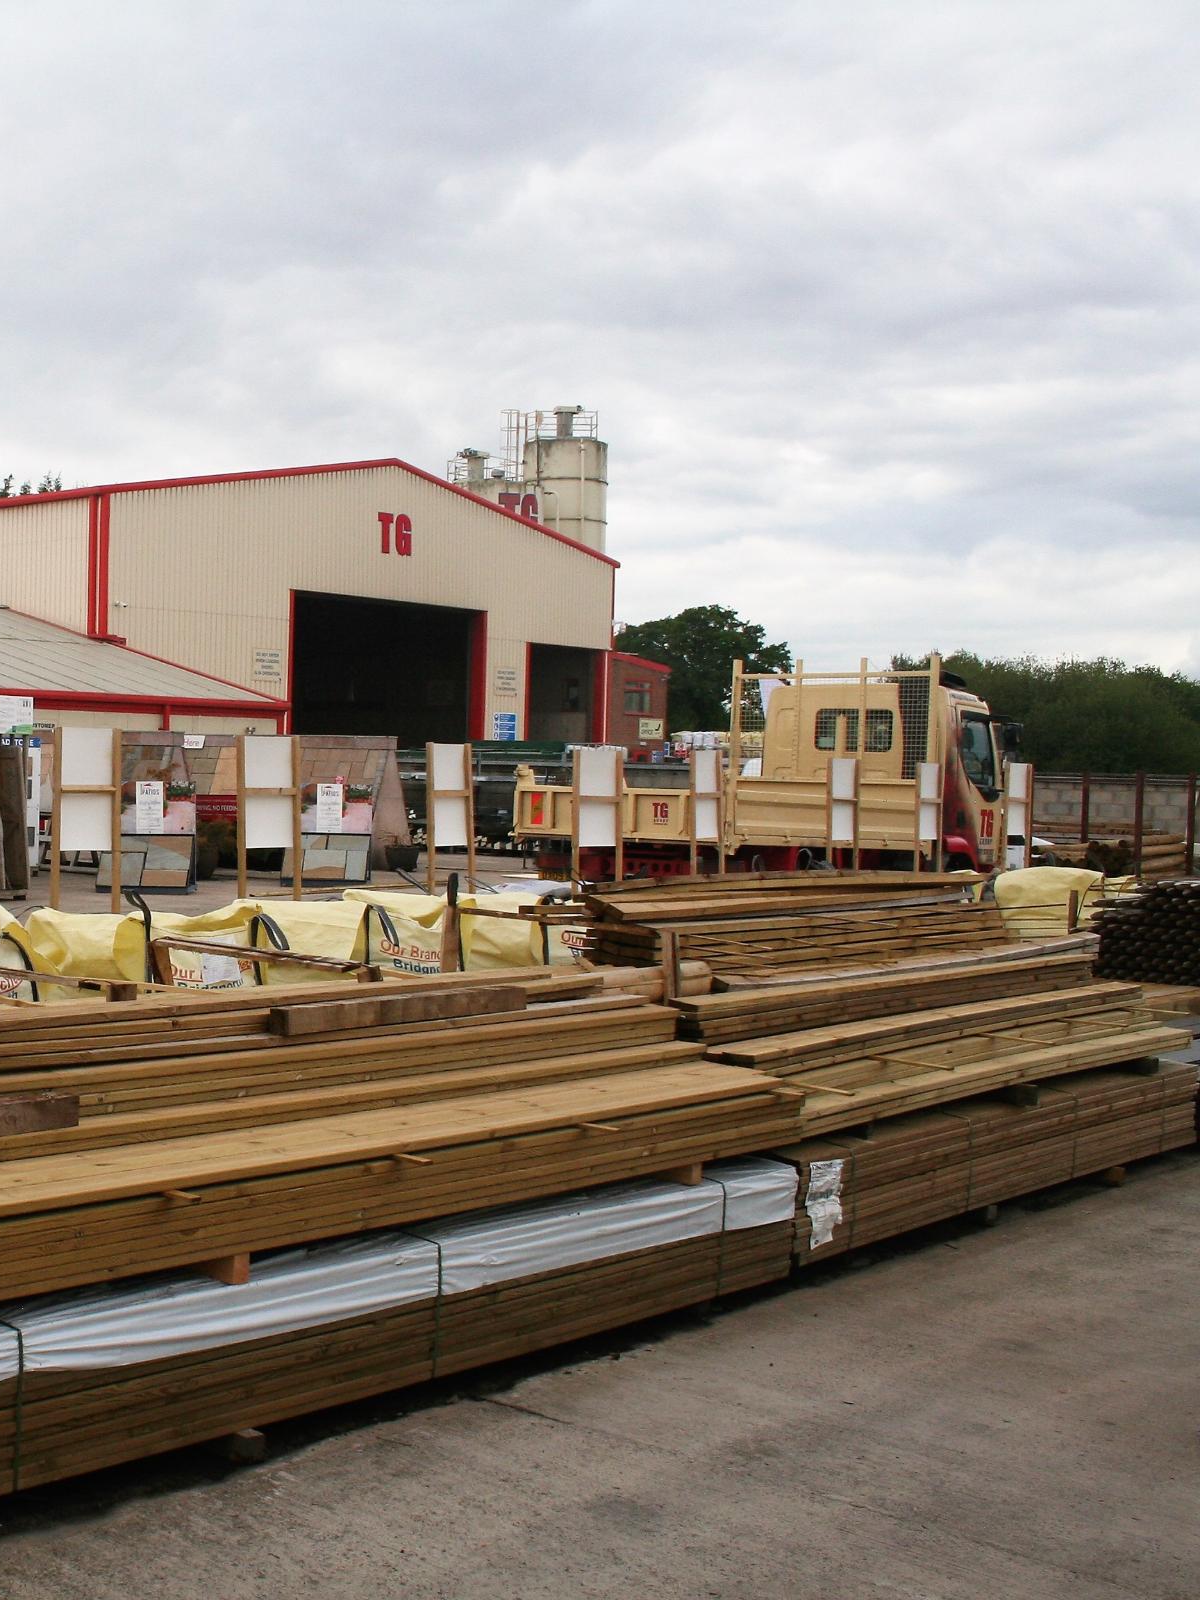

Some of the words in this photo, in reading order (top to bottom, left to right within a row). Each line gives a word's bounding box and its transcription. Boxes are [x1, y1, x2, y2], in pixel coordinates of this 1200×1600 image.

[499, 493, 538, 523] TG
[378, 512, 412, 557] TG
[652, 802, 668, 818] TG
[980, 809, 993, 837] TG
[380, 939, 407, 956] Our
